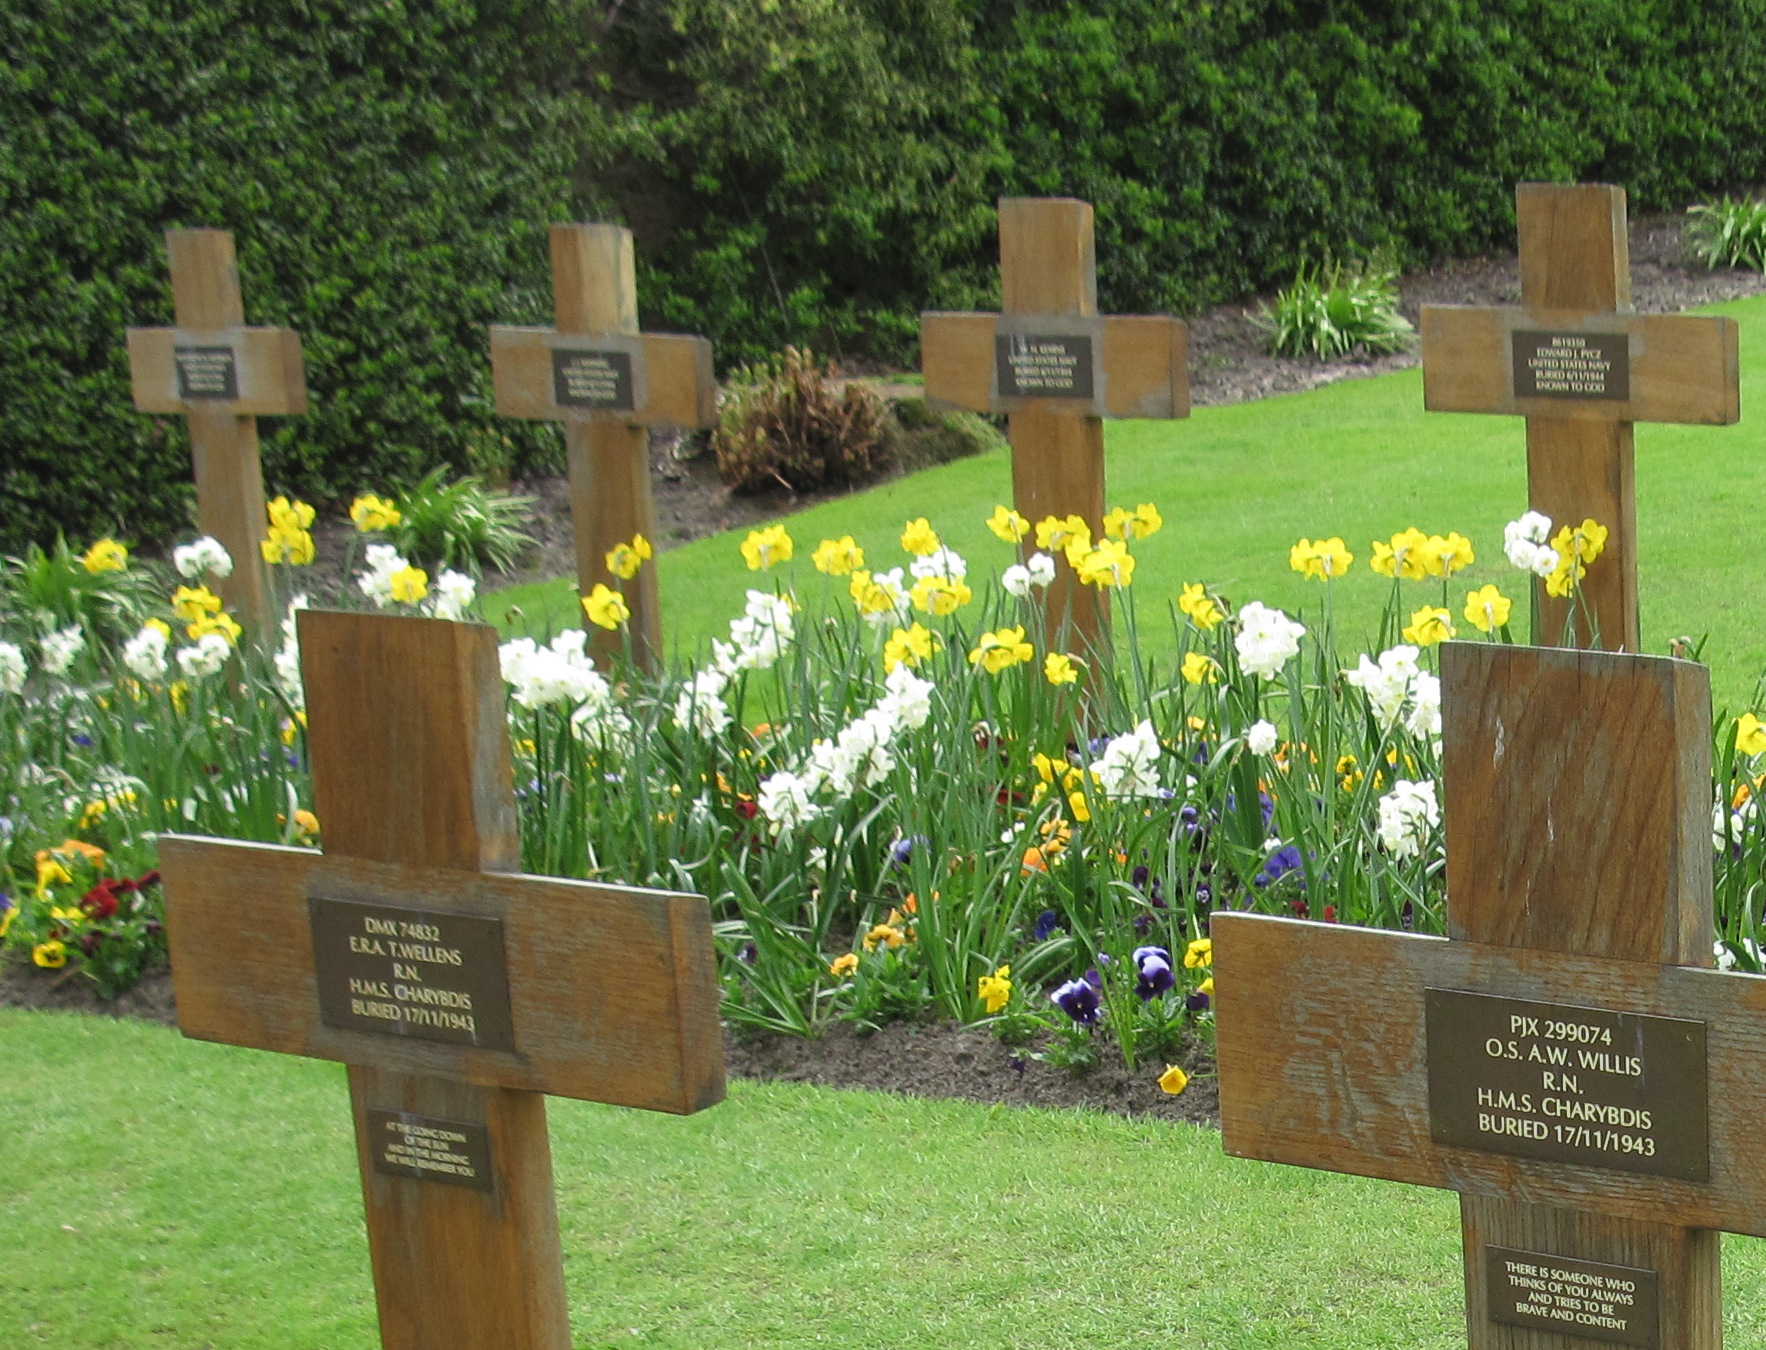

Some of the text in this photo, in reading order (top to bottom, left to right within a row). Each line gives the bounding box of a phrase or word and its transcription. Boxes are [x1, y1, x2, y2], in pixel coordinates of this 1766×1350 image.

[1528, 358, 1611, 370] UNITED STATES NAVY
[1537, 347, 1572, 358] EDWARD
[1536, 370, 1565, 380] BURIED
[1536, 381, 1605, 392] KNOWN TO GOD
[365, 917, 440, 942] DMX 74832
[393, 963, 421, 981] R.N.
[350, 979, 472, 1010] H.M.S. CHARYBDIS
[351, 1000, 475, 1031] BURIED 17/11/1943
[1510, 1015, 1612, 1046] PJX 299074
[1486, 1039, 1641, 1077] O.S. A.W. WILLIS
[1543, 1072, 1584, 1095] R.N.
[1478, 1088, 1652, 1130] H.M.S. CHARYBDIS
[1479, 1113, 1656, 1157] BURIED 17/11/1943
[1505, 1261, 1635, 1292] THERE IS SOMEONE WHO
[1508, 1275, 1634, 1305] THINKS OF YOU ALWAYS
[1515, 1302, 1627, 1331] BRAVE AND CONTENT
[1528, 1292, 1614, 1315] AND TRIES TO BE
